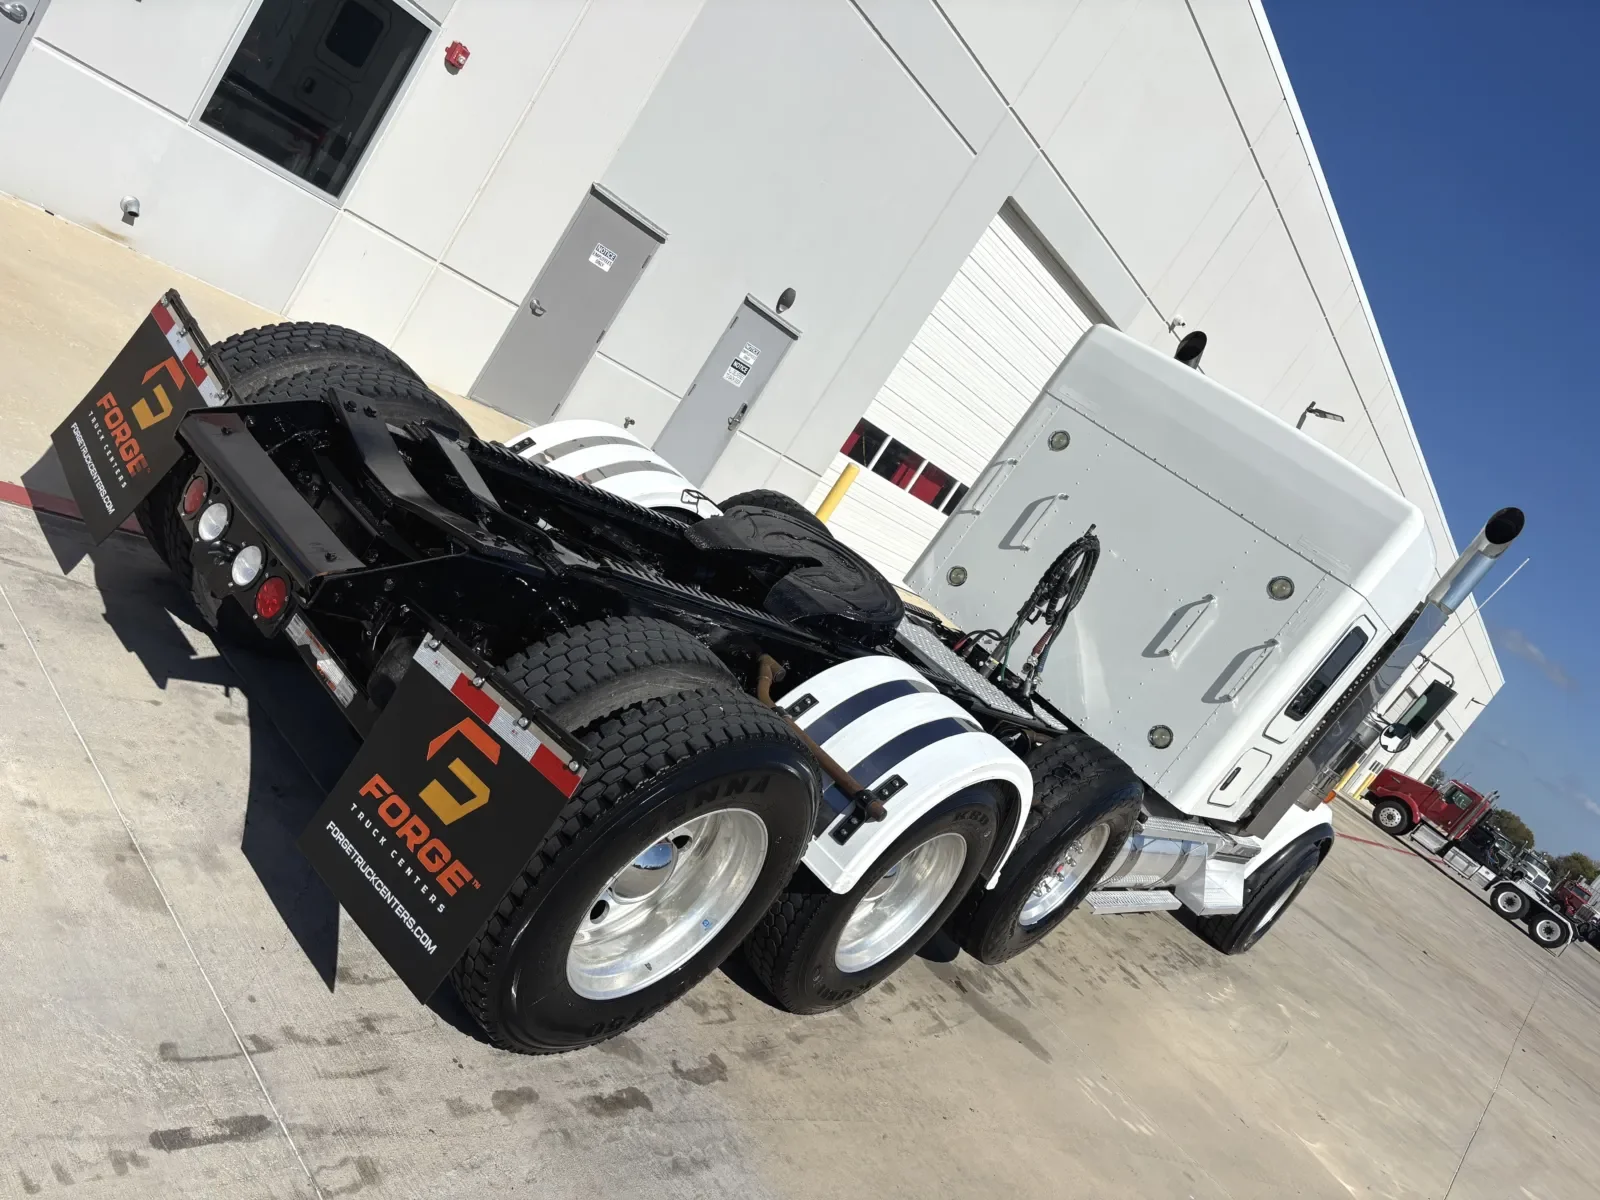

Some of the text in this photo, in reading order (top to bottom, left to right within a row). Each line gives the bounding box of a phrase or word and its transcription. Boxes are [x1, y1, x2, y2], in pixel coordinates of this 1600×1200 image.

[596, 244, 616, 261] NOTICE
[732, 361, 748, 373] NOTICE
[70, 421, 116, 515] FORGETRUCKCENTERS.COM
[88, 411, 127, 489] TRUCK CENTERS
[96, 391, 149, 478] FORGE
[350, 802, 446, 913] TRUCK CENTERS
[358, 773, 474, 897] FORGE
[326, 820, 438, 956] FORGETRUCKCENTERS.COM
